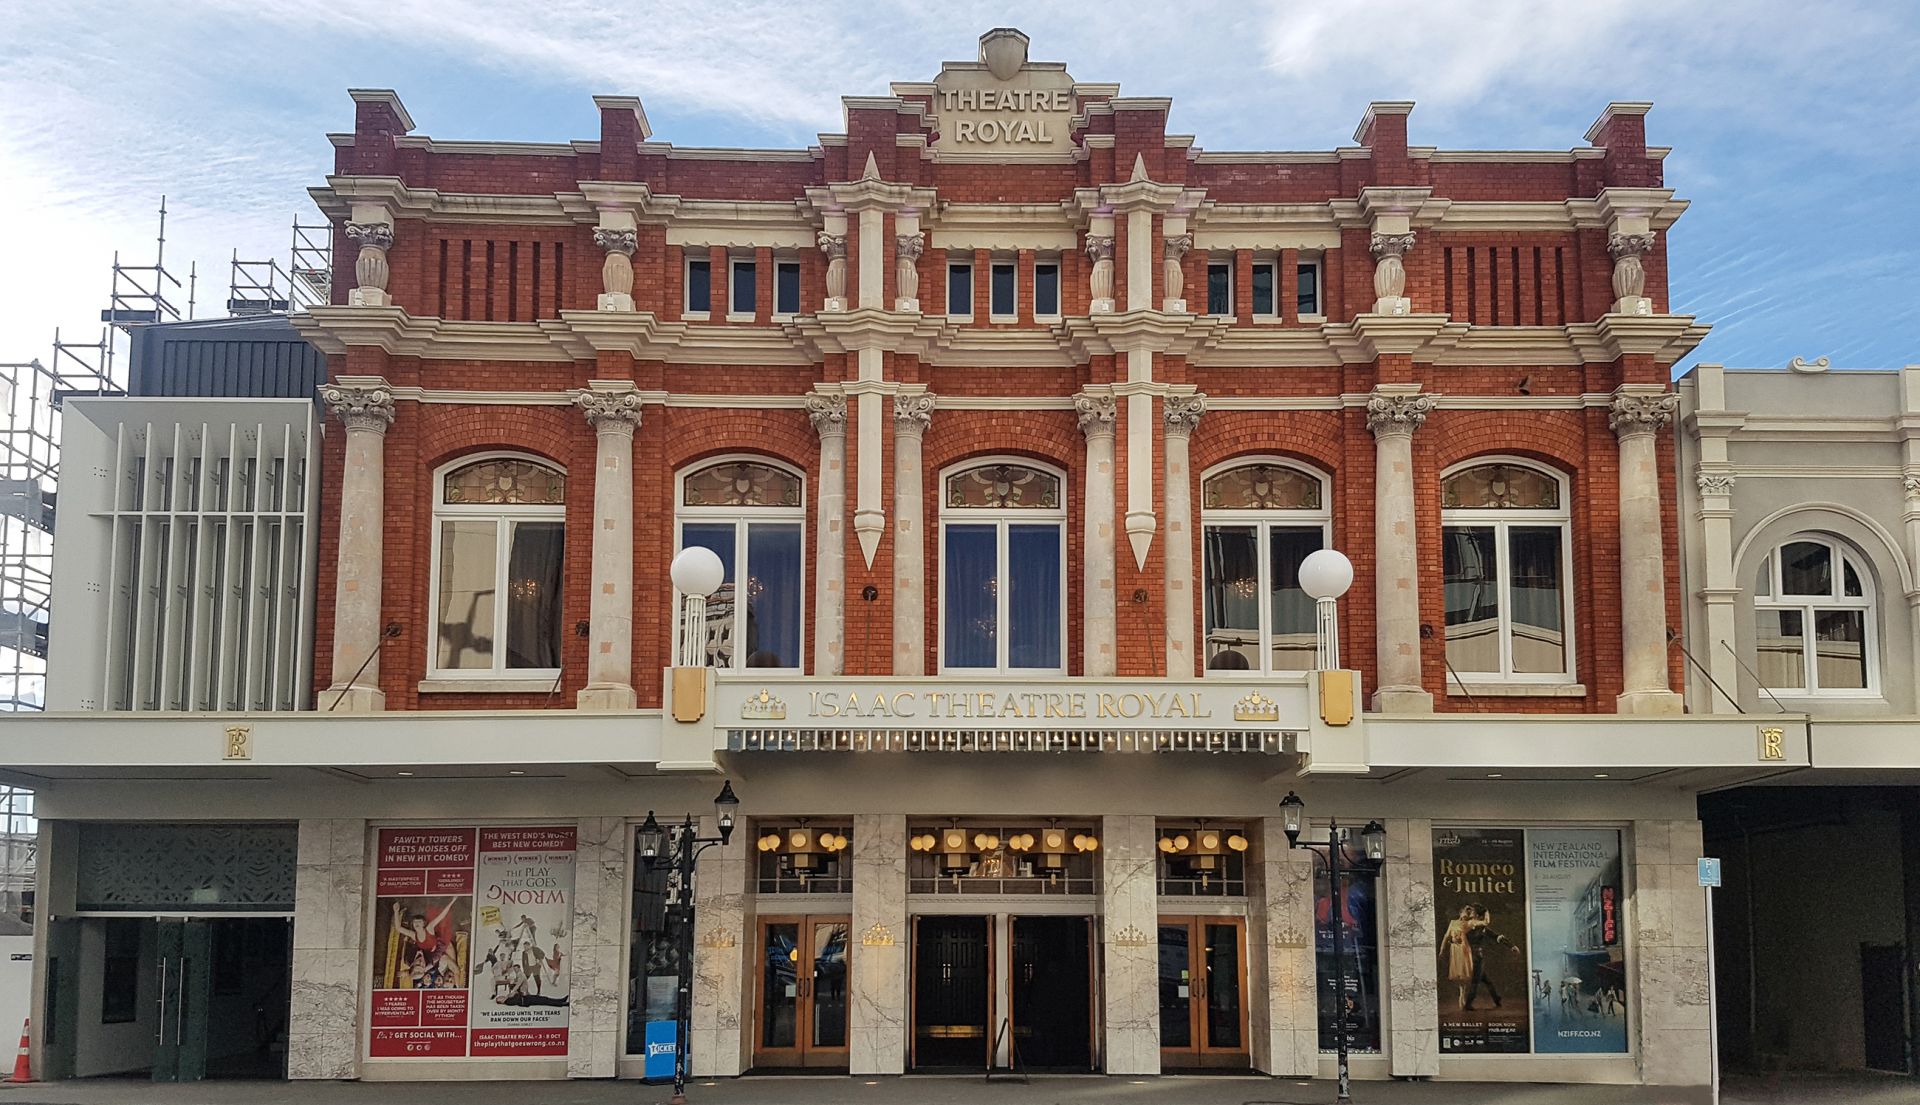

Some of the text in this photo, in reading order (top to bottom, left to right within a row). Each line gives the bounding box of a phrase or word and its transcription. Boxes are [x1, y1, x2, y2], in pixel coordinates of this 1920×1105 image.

[941, 89, 1070, 111] THEATRE
[955, 120, 1053, 143] ROYAL
[808, 691, 1212, 718] ISAAC THEATRE ROYAL
[429, 835, 463, 843] TOWERS
[388, 845, 416, 853] MEETS
[451, 844, 468, 852] OFF
[1533, 842, 1601, 850] NEW ZEALAND
[417, 854, 431, 862] HIT
[433, 854, 470, 862] COMEDY
[1533, 851, 1610, 859] INTERNATIONAL
[1440, 859, 1514, 875] Romeo
[1534, 860, 1601, 868] FILM FESTIVAL
[525, 867, 552, 877] PLAY
[502, 877, 557, 887] THAT GOES
[1443, 876, 1515, 894] & Juliet
[486, 884, 565, 905] WRONG
